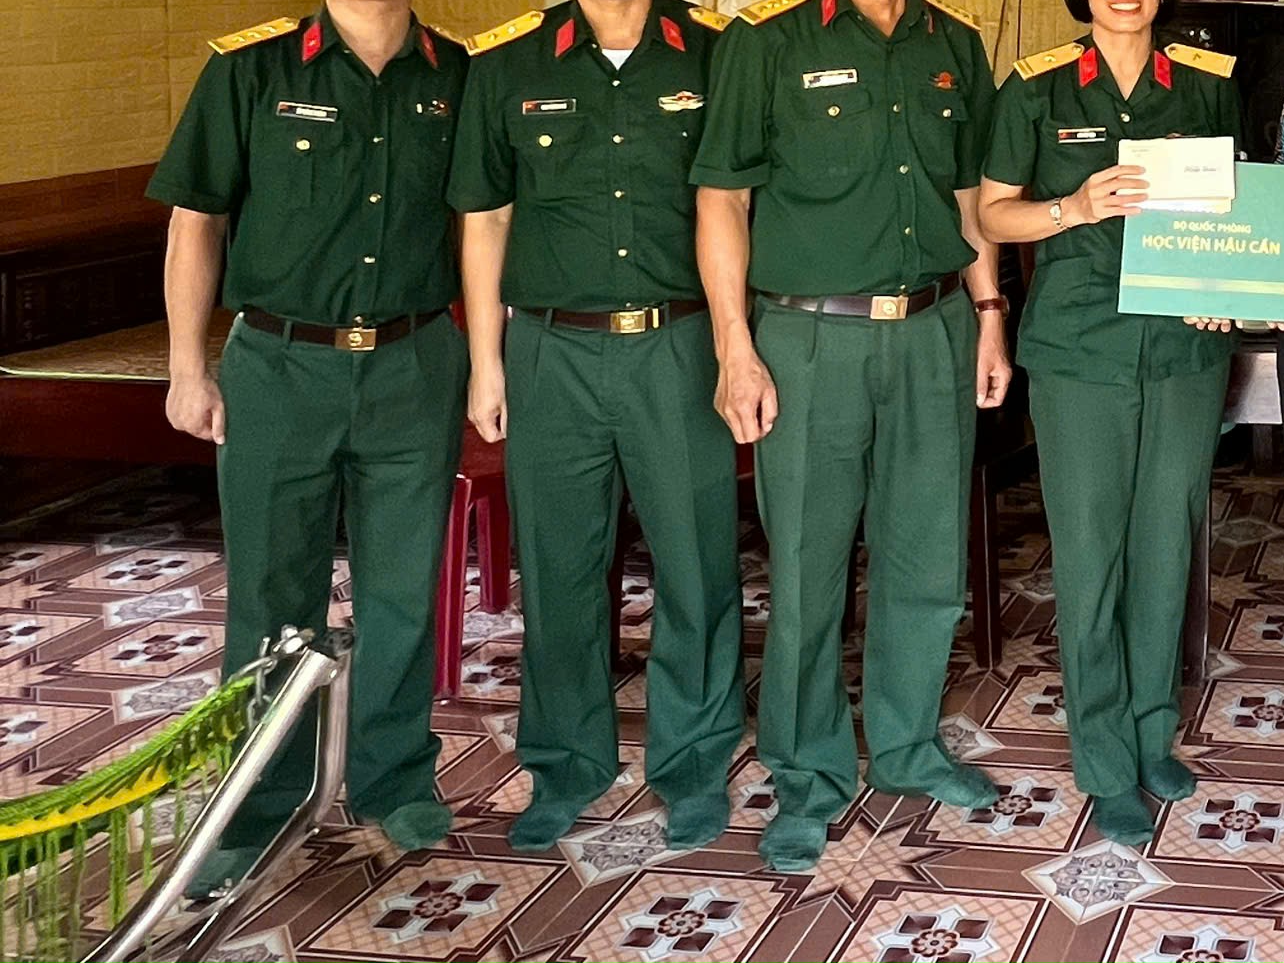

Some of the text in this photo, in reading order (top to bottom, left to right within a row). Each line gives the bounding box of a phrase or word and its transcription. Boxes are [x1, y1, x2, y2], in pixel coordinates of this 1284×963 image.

[1142, 235, 1175, 251] HỌC
[1176, 234, 1211, 253] VIỆN
[1213, 236, 1246, 255] HẬU
